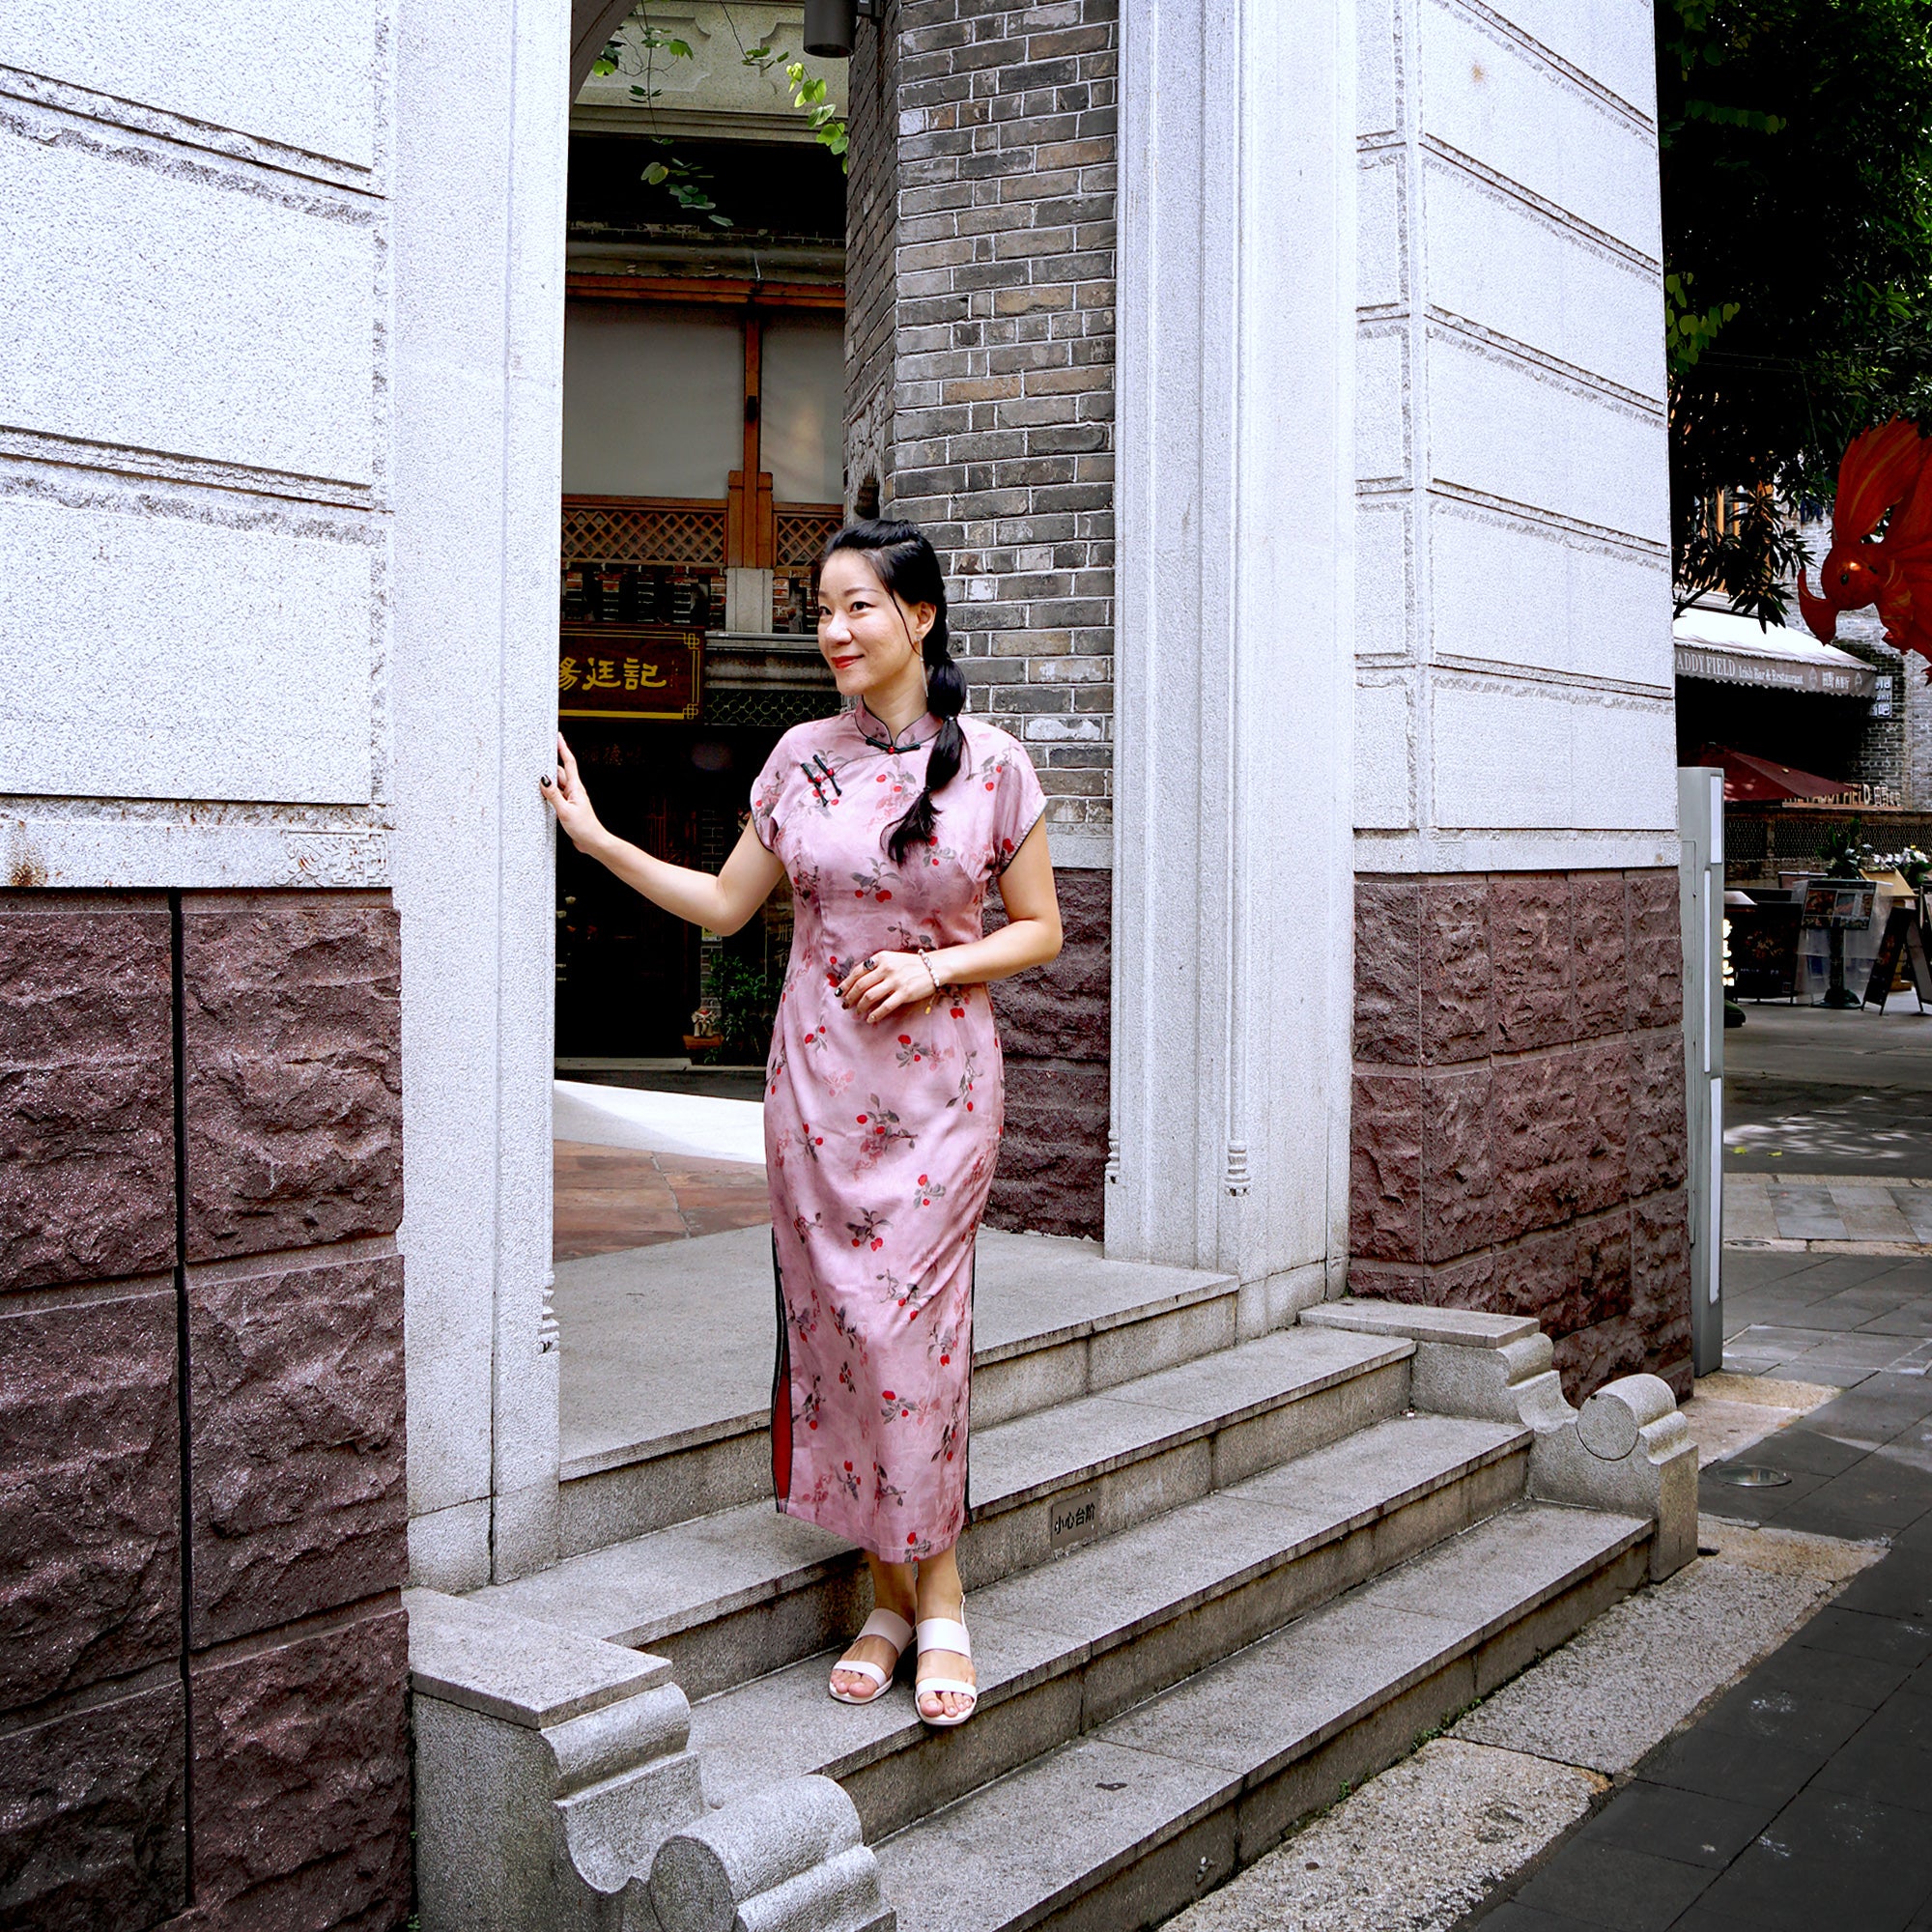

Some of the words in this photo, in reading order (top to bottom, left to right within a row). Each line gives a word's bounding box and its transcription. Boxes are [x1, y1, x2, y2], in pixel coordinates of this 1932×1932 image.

[1706, 654, 1736, 677] FIELD
[1739, 665, 1753, 679] Irish
[1754, 667, 1765, 680] Bar
[1772, 668, 1804, 684] Restaurant
[1054, 1502, 1095, 1535] 小心台阶
